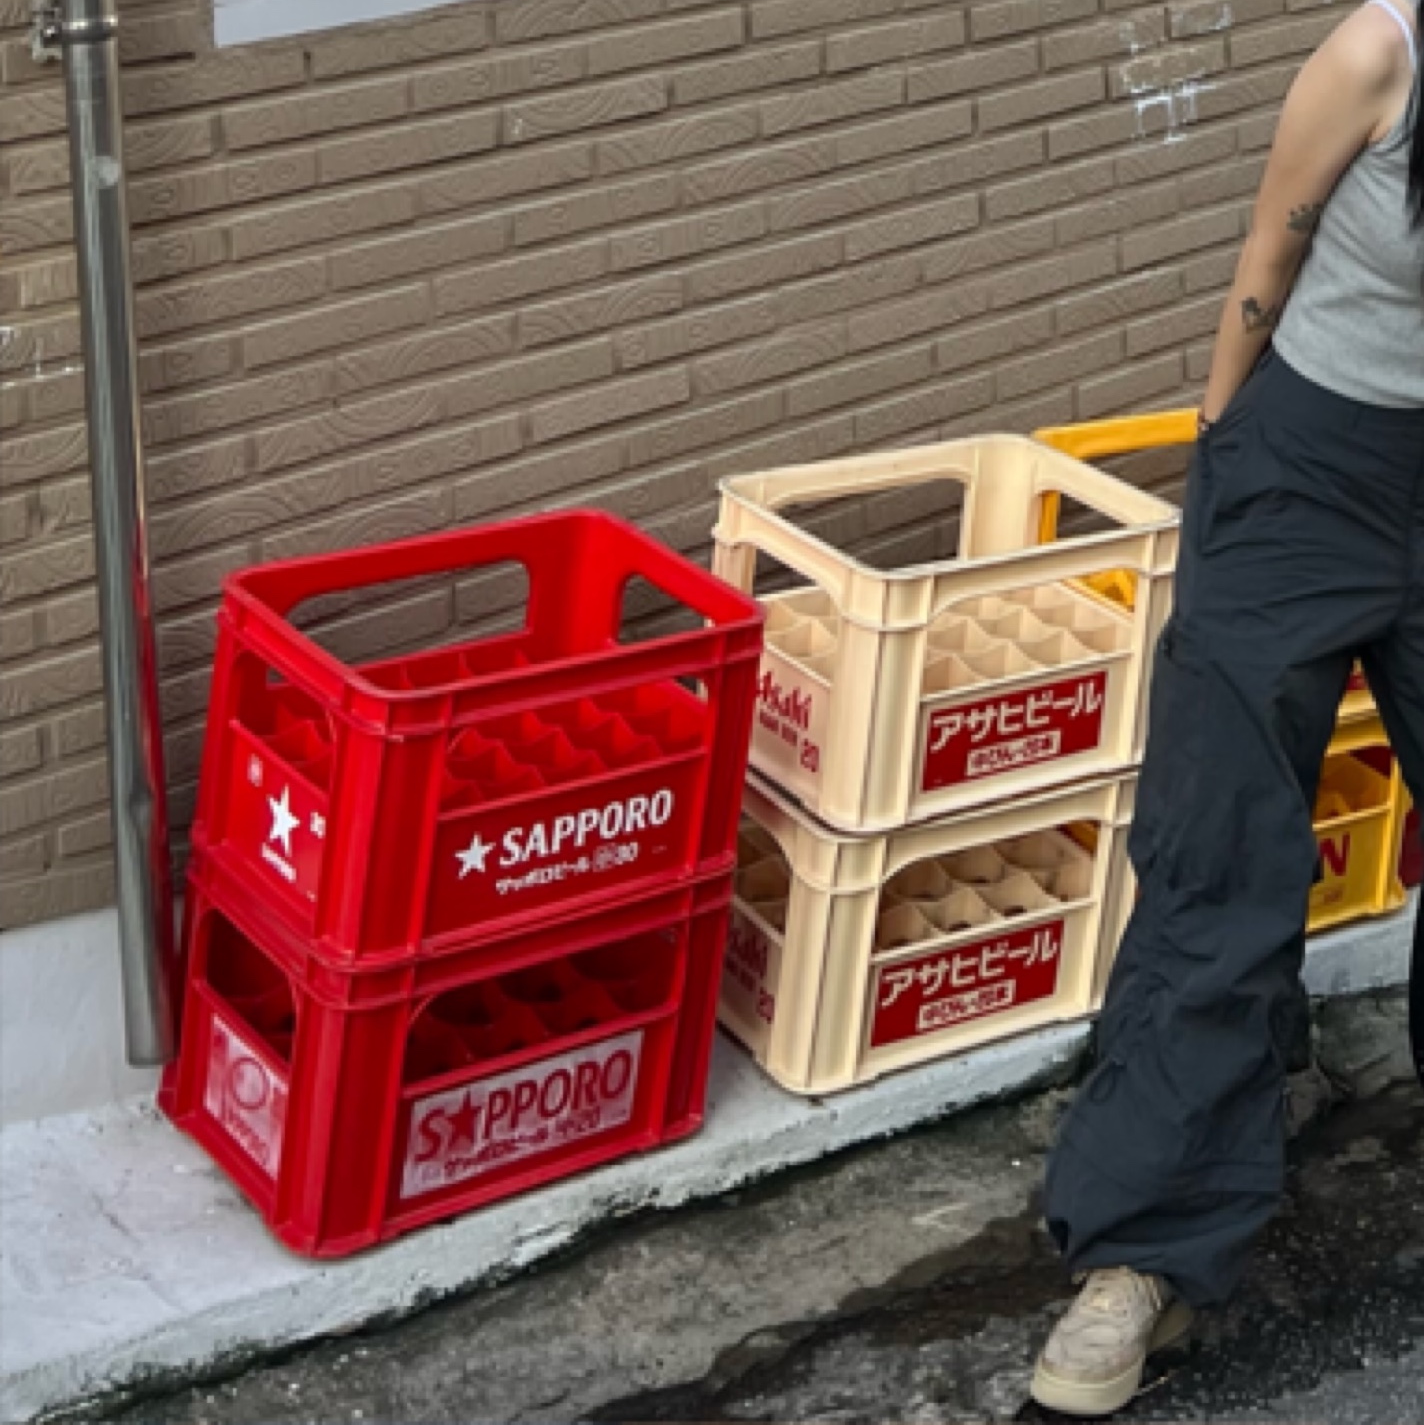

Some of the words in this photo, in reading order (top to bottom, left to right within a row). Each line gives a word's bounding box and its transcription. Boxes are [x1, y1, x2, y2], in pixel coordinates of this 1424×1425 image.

[930, 681, 1102, 754] アサヒビール
[499, 788, 674, 866] SAPPORO
[881, 930, 1057, 1009] アサヒビール
